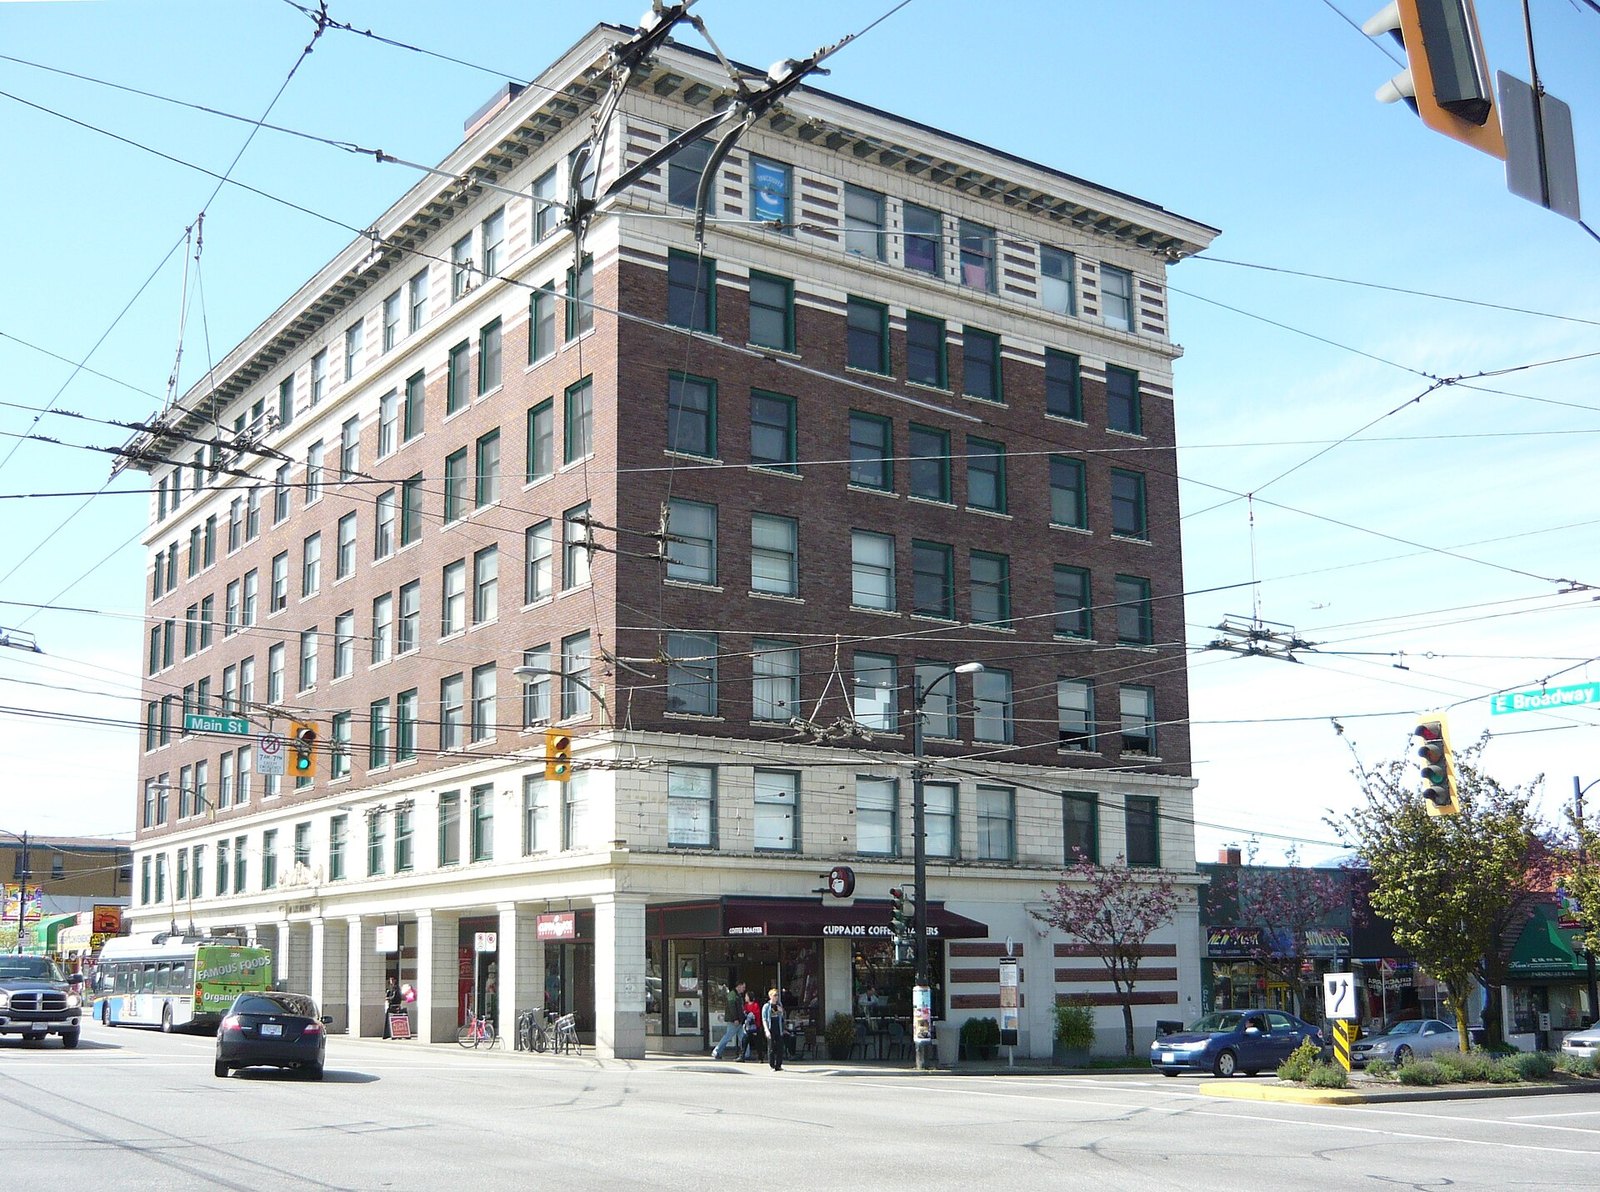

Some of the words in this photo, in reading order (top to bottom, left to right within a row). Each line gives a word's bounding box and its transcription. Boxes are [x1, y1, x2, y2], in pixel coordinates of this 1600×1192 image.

[1496, 695, 1506, 711] E
[1513, 689, 1594, 709] Broadway
[191, 718, 222, 731] Main
[228, 722, 242, 733] St
[823, 925, 865, 935] CUPPAJOE
[868, 926, 896, 936] COFFE
[198, 963, 237, 980] FAMOUS
[240, 955, 271, 970] FOODS
